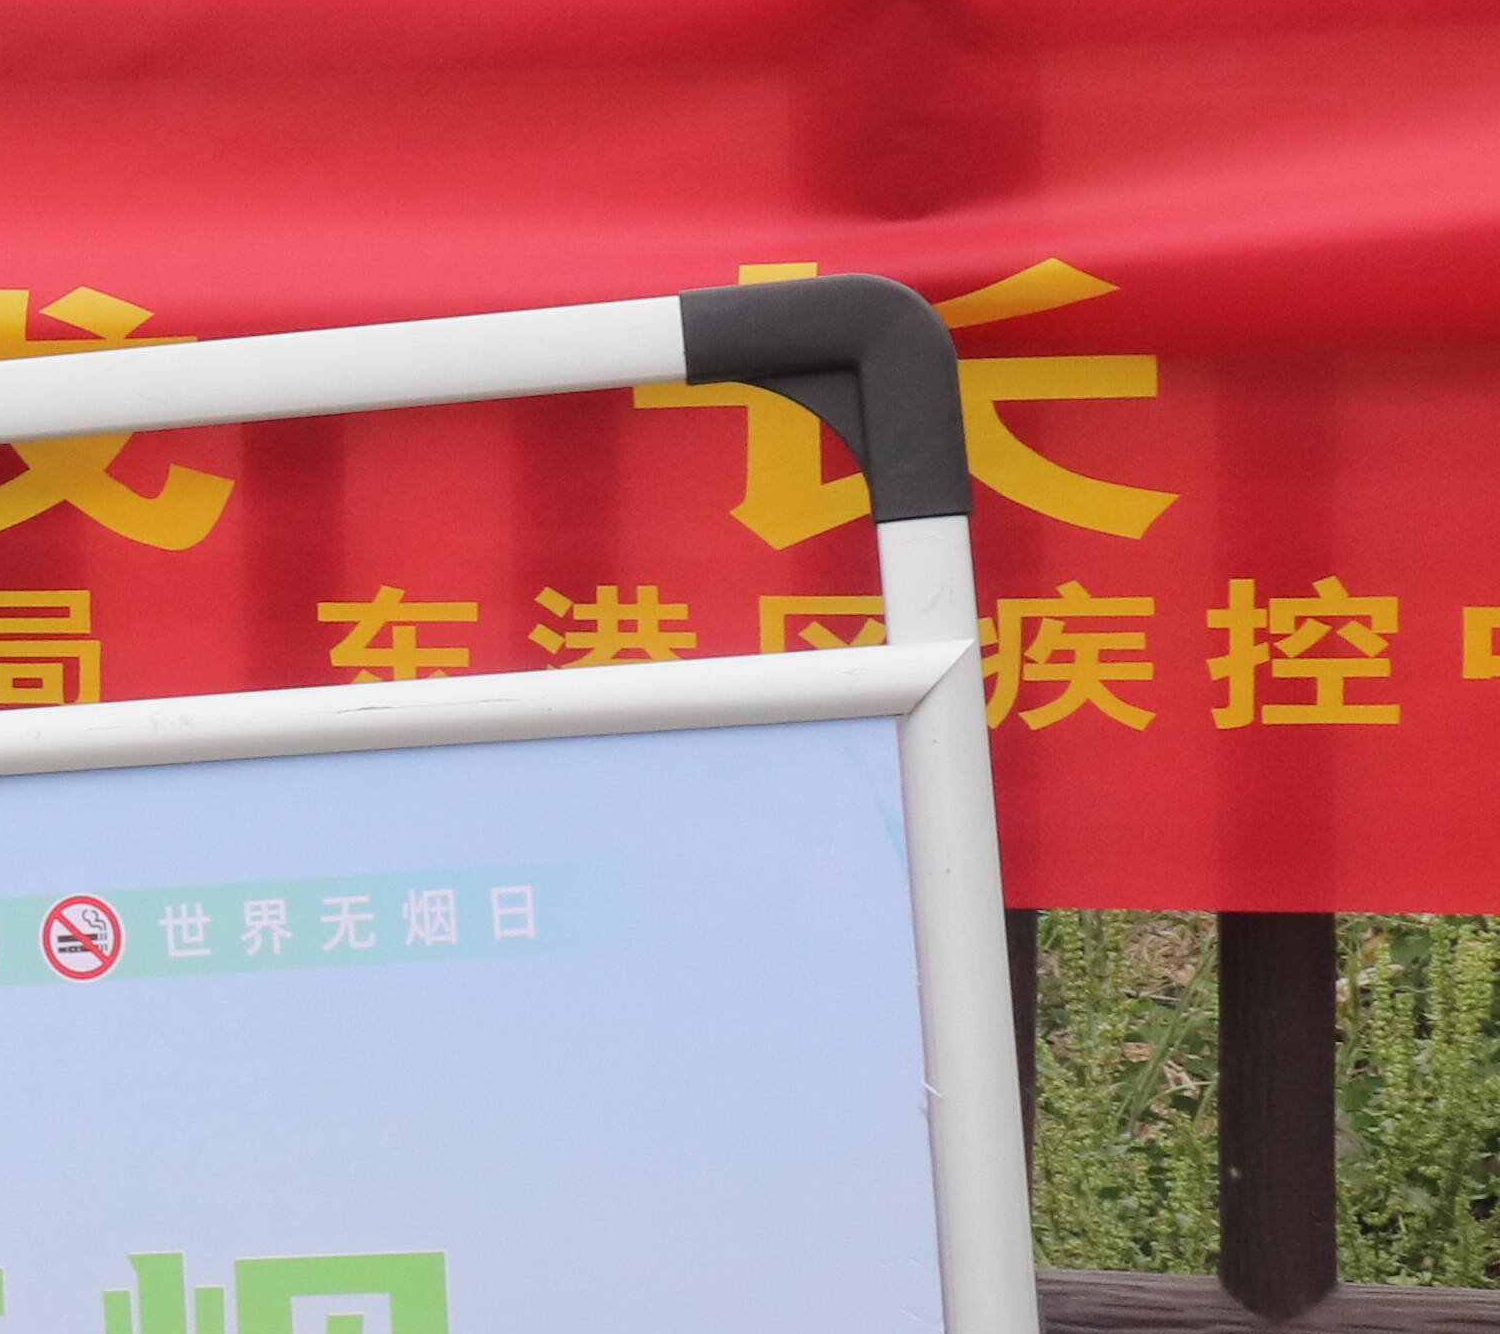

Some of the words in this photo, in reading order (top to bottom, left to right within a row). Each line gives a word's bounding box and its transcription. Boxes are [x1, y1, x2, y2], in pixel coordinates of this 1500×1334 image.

[157, 882, 540, 962] 世界无烟日
